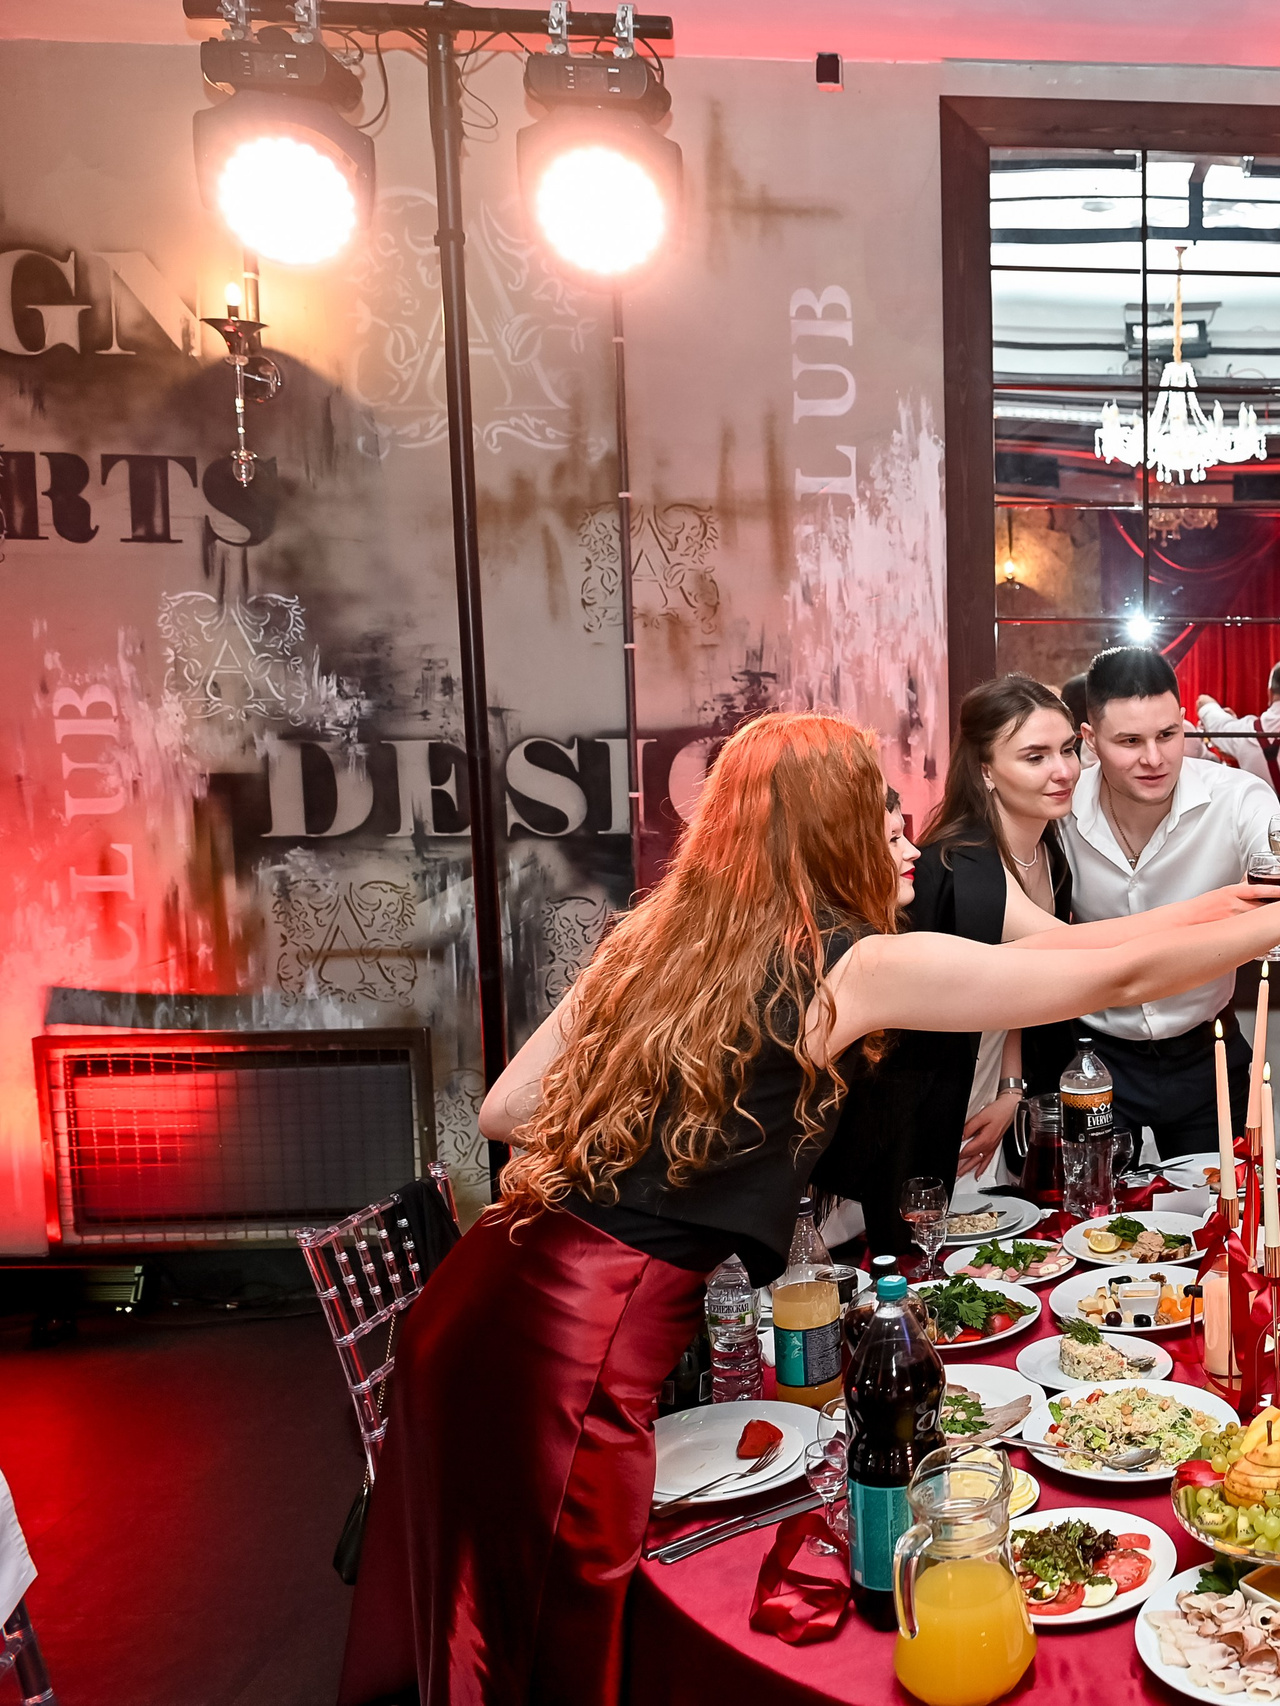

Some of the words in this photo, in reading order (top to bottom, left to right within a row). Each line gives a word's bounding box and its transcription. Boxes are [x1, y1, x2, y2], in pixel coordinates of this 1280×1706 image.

[788, 283, 858, 545] LUB
[52, 683, 141, 976] CLUB
[709, 1302, 749, 1314] СЕНЕЖСКАЯ
